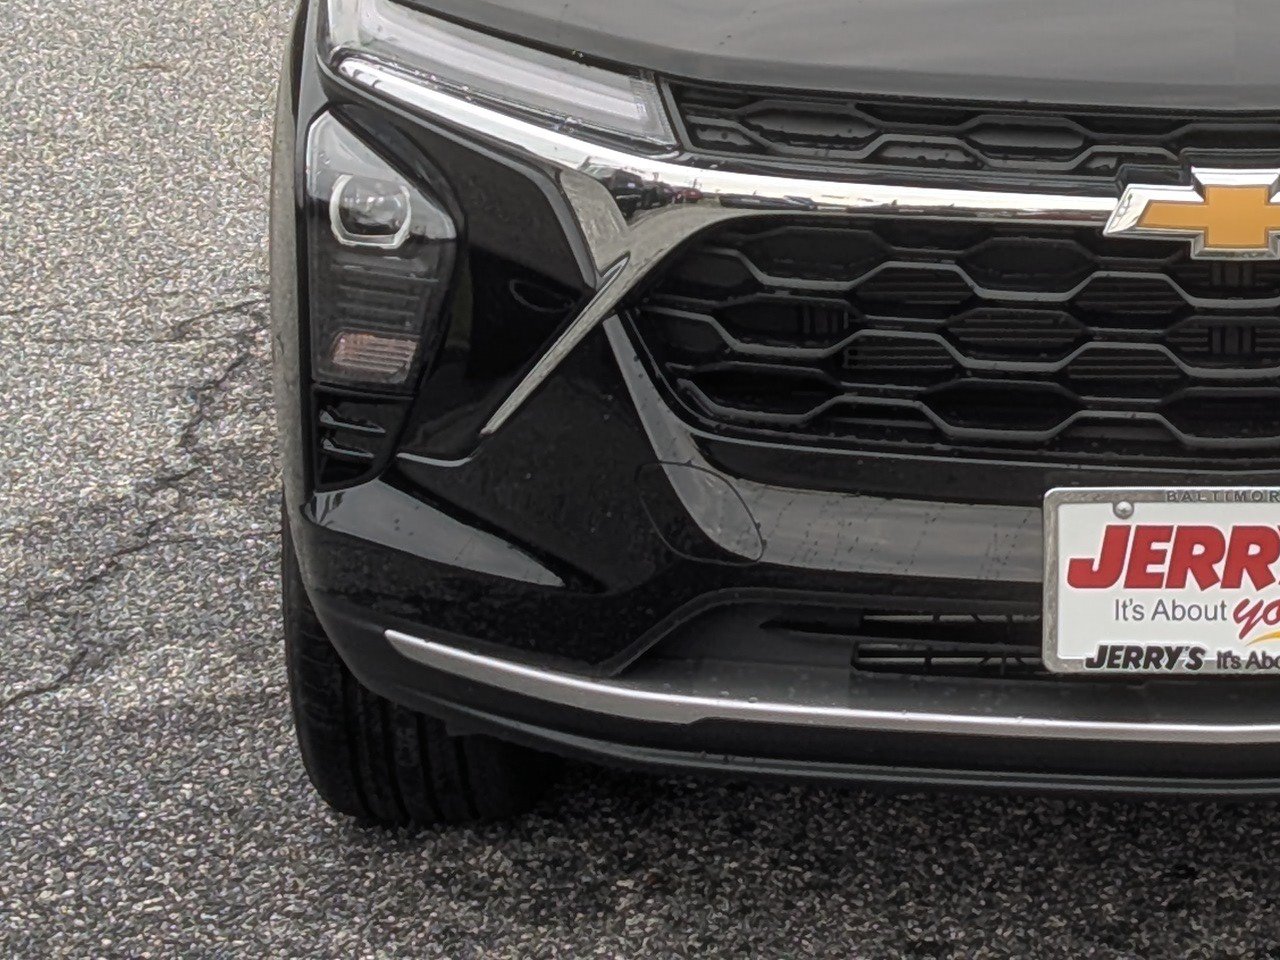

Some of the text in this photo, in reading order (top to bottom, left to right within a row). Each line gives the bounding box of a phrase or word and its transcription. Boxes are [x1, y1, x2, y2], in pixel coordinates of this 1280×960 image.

[1114, 598, 1145, 621] It's
[1151, 598, 1227, 621] About
[1085, 644, 1206, 670] JERRY'S
[1216, 650, 1241, 670] It's
